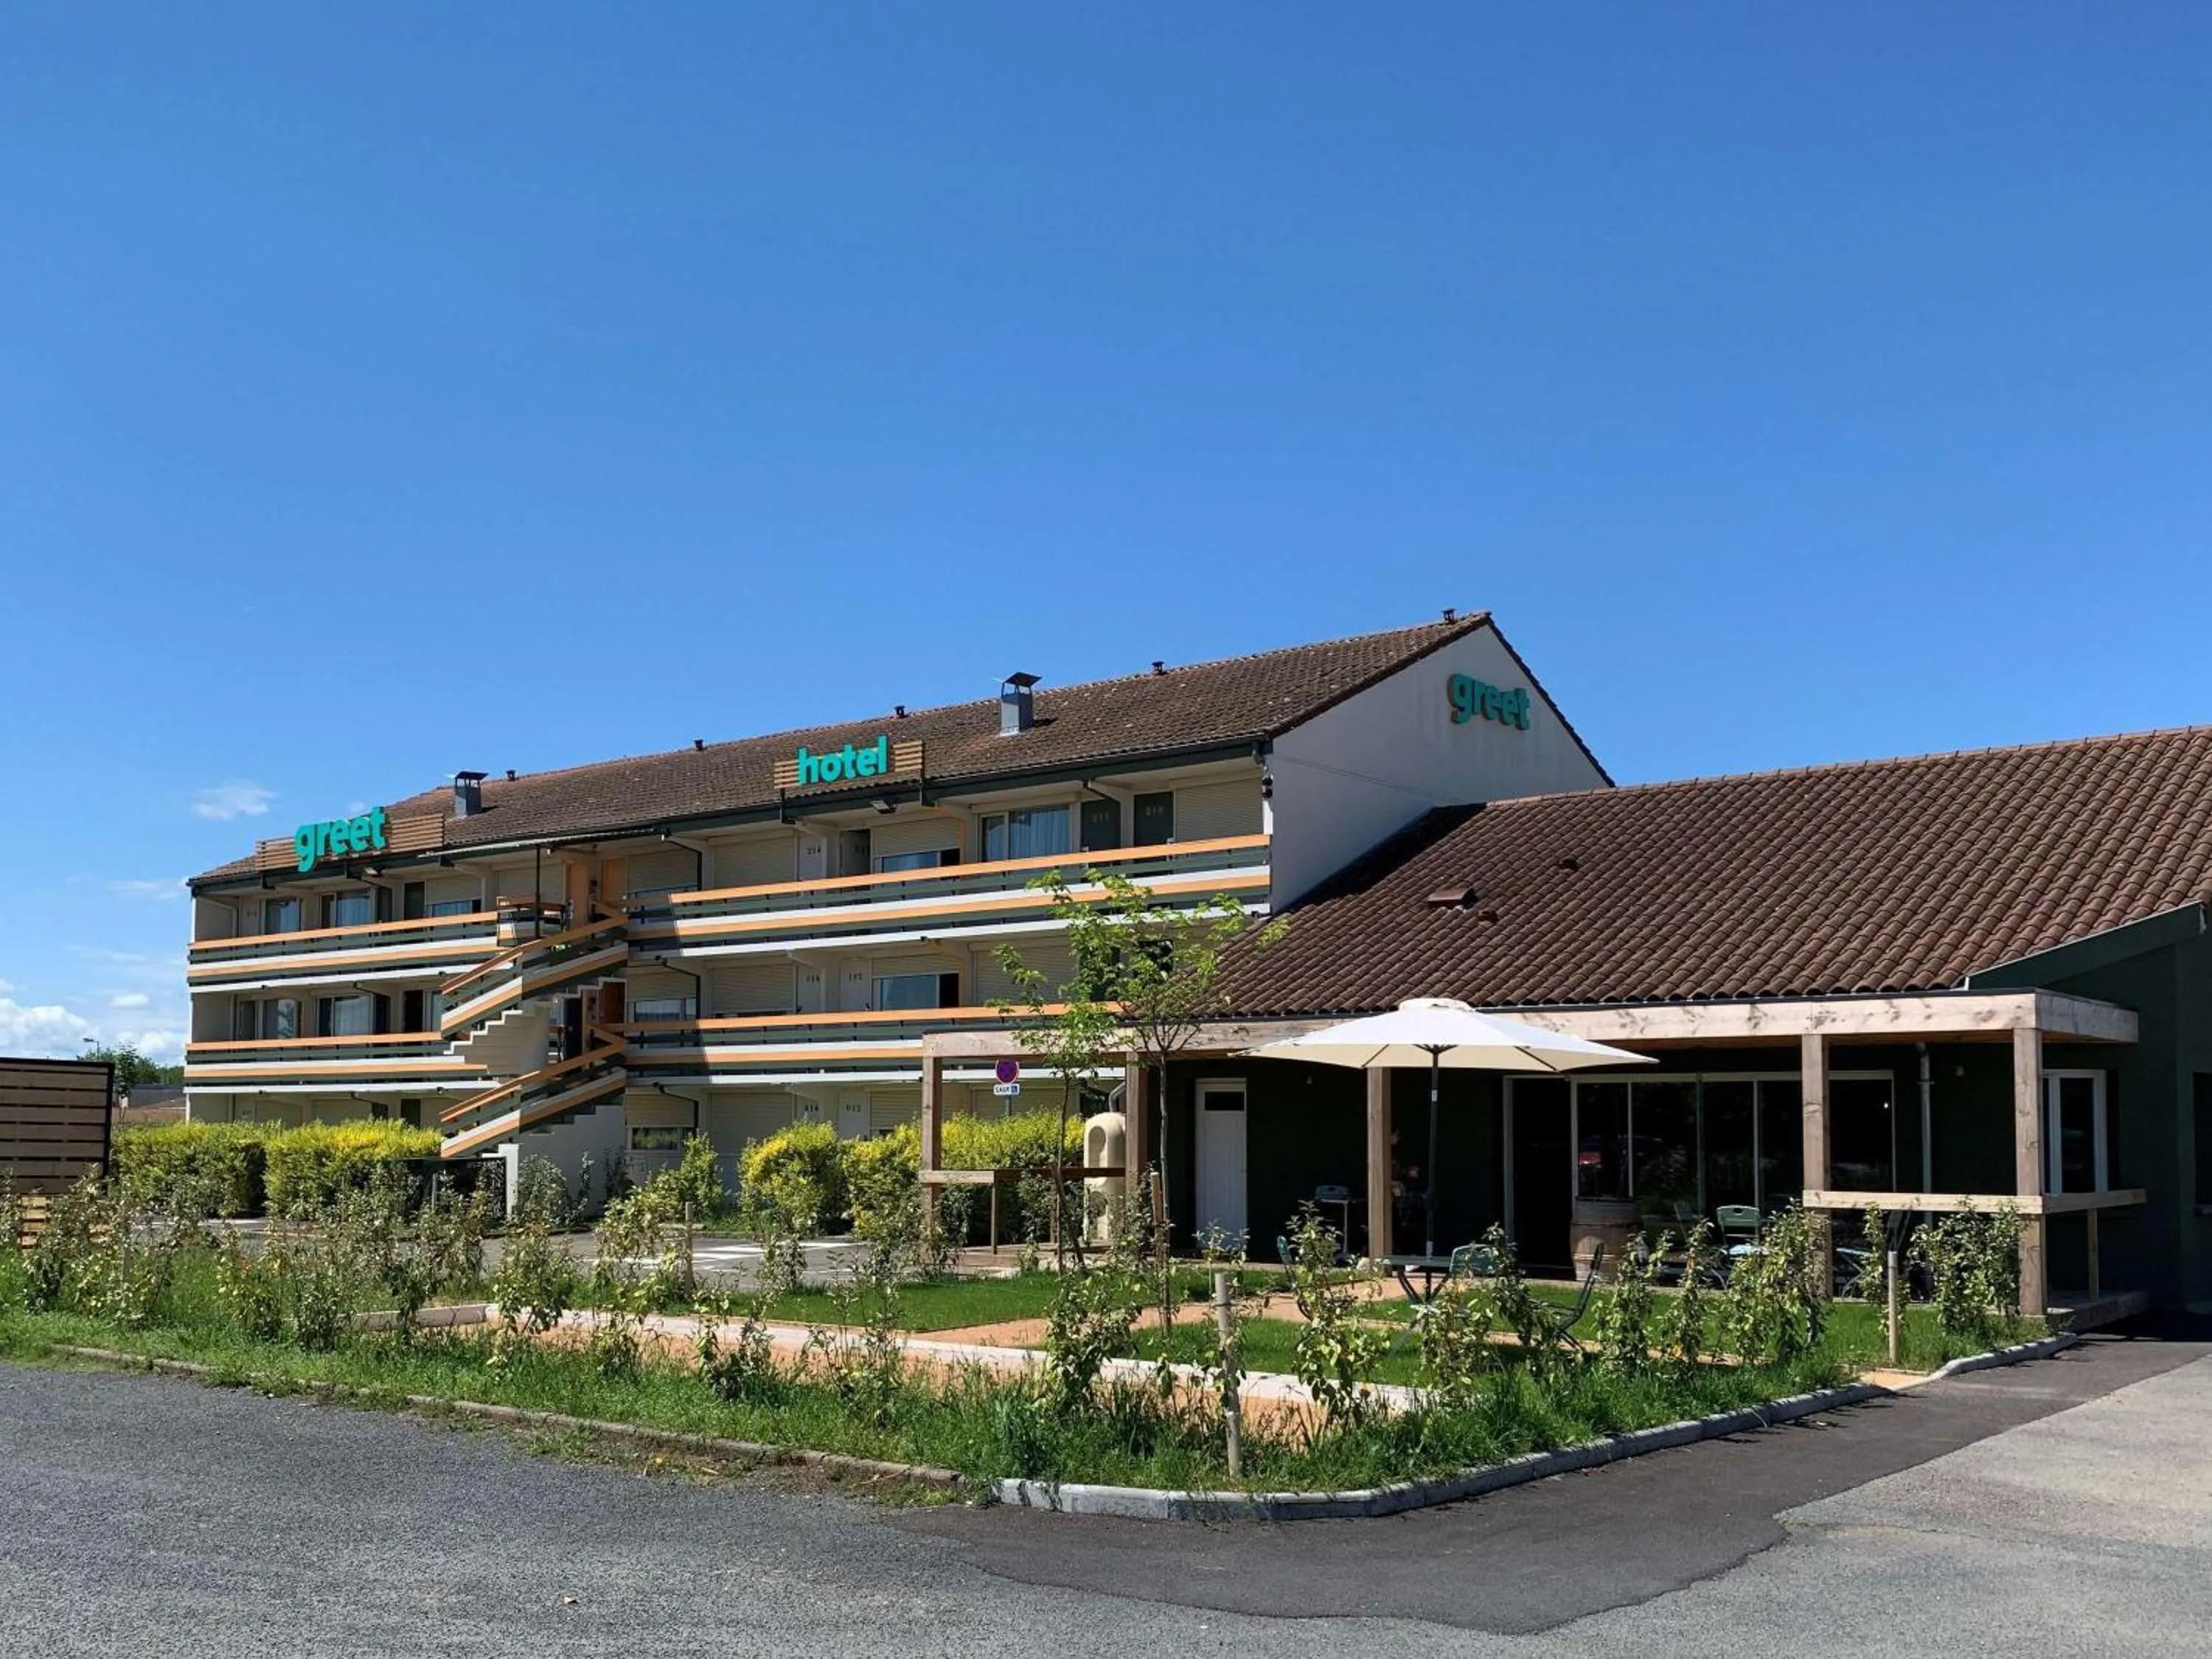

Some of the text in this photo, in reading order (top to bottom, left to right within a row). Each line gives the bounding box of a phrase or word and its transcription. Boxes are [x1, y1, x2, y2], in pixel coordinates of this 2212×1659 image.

[1447, 673, 1530, 731] greet
[796, 733, 888, 785] hotel
[295, 806, 387, 872] greet
